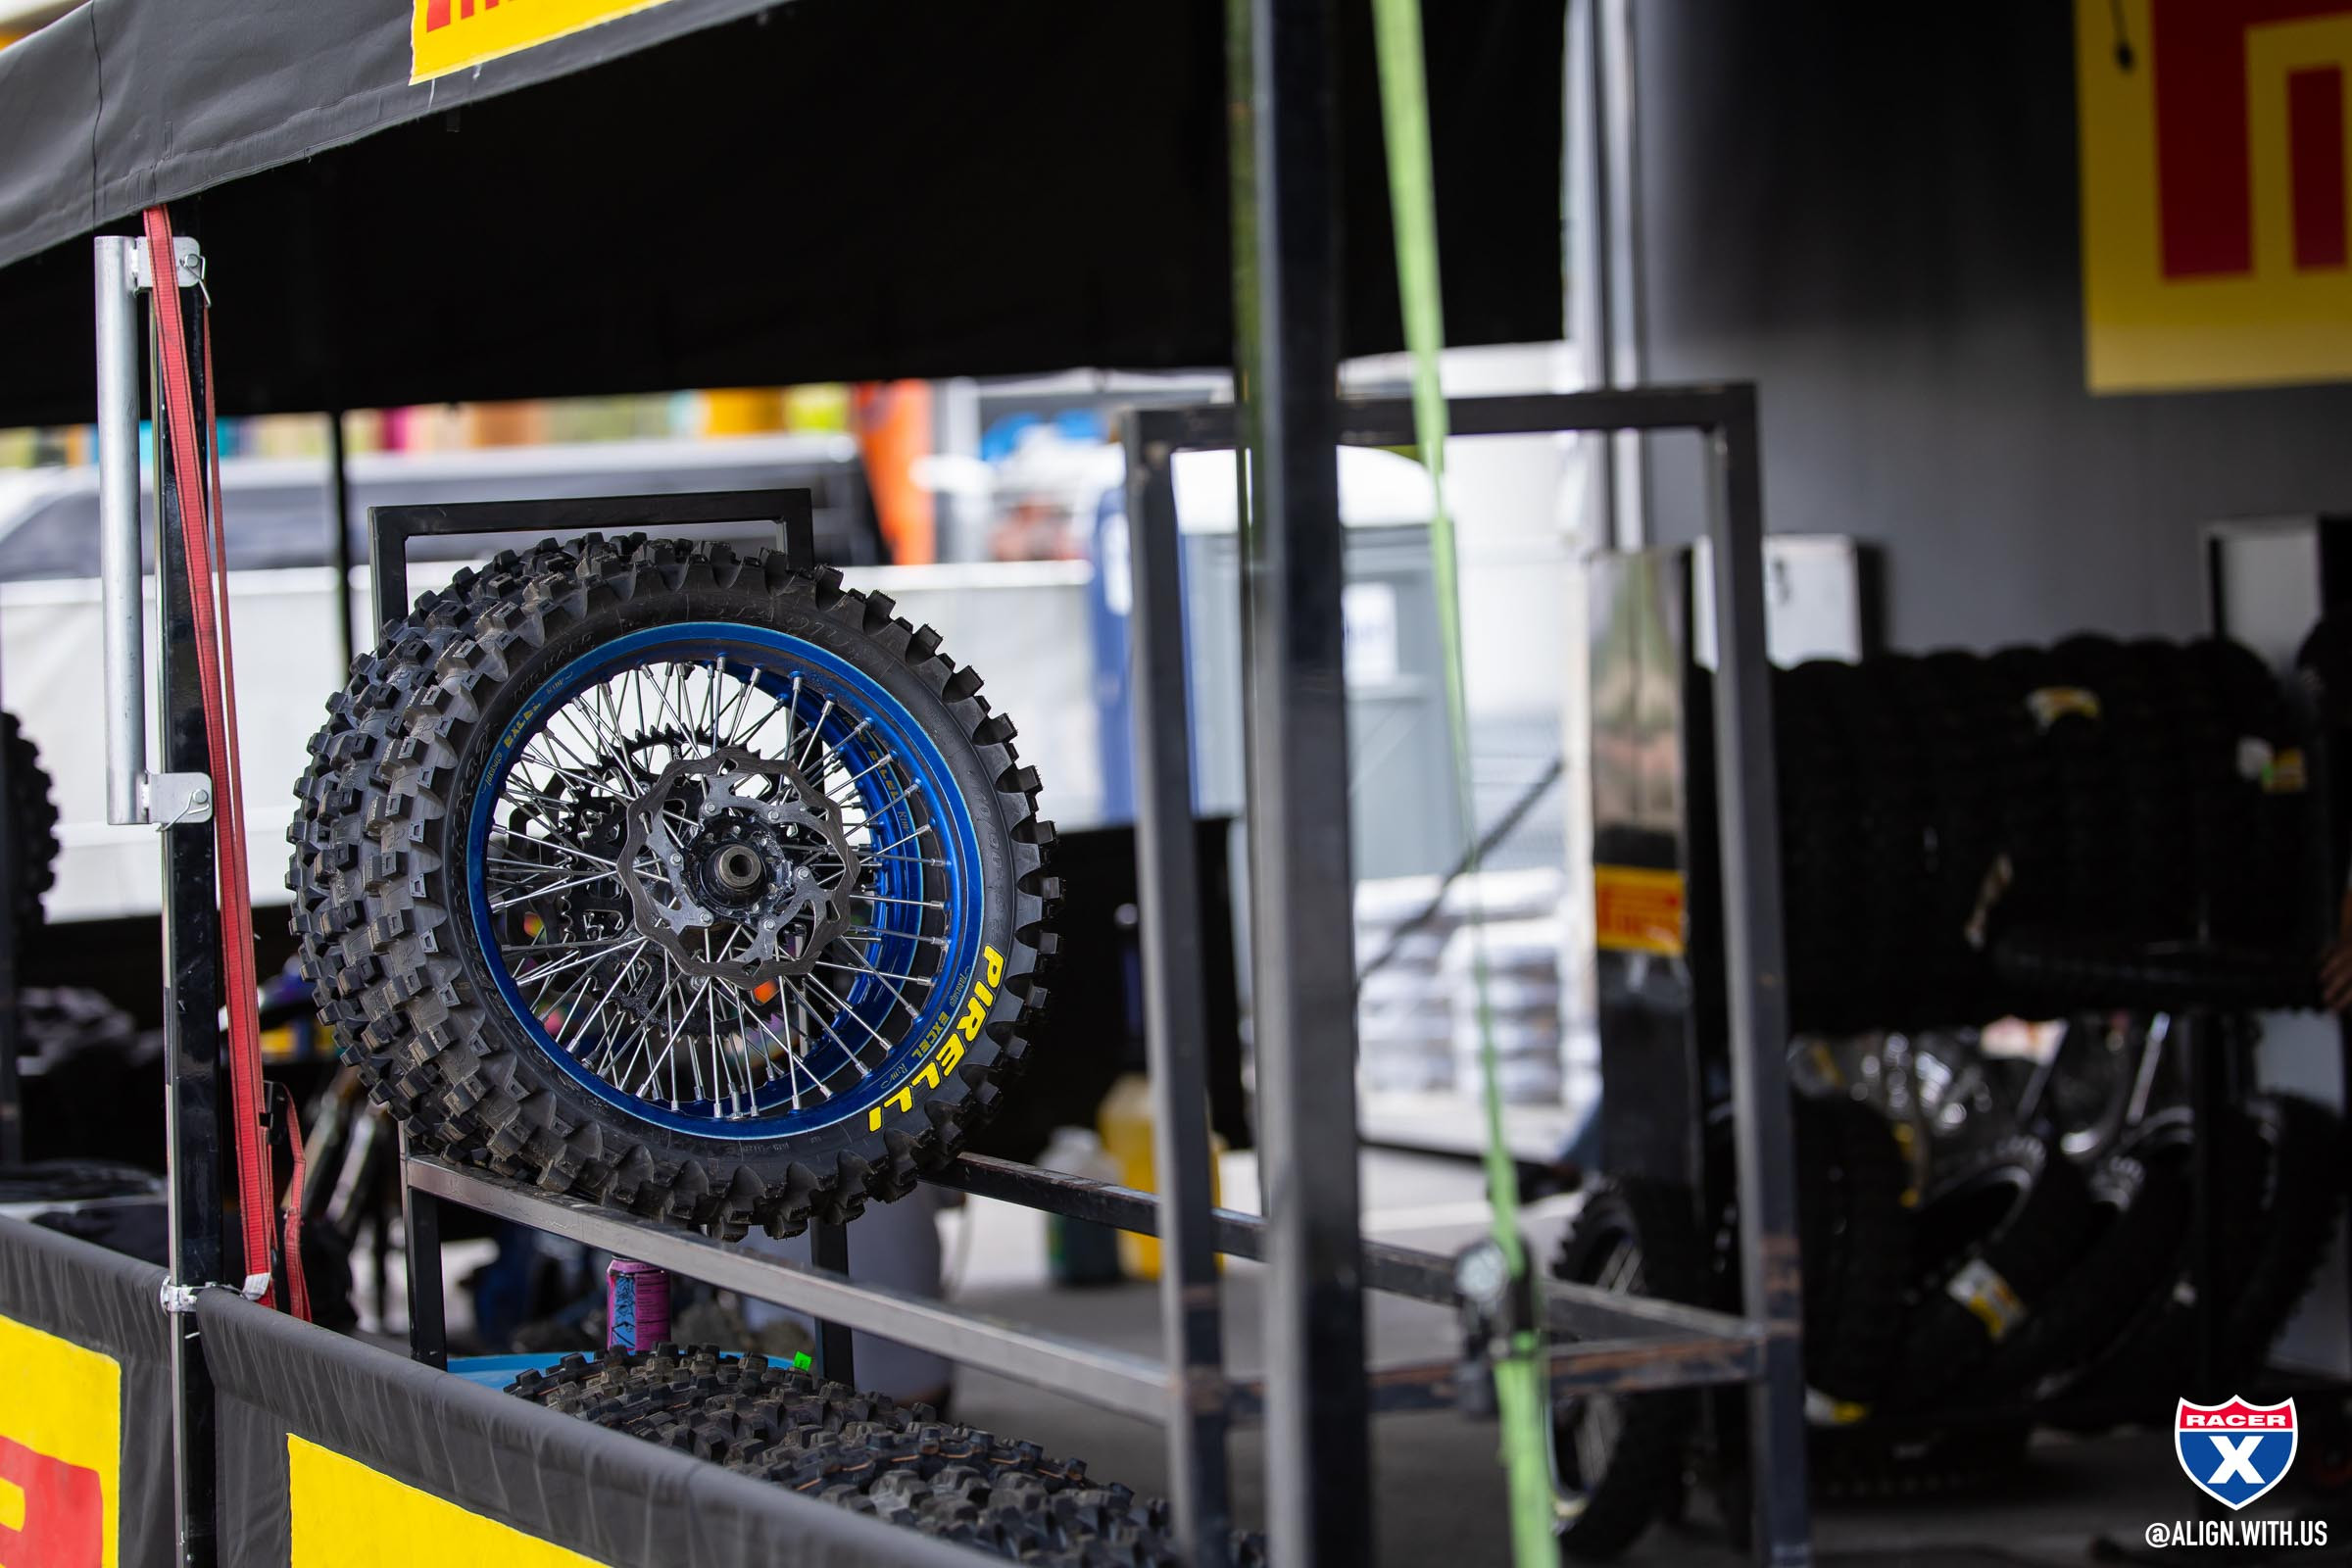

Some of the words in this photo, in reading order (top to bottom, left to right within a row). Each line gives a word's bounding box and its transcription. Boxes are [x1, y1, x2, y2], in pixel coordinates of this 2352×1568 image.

[868, 945, 1004, 1132] PIRELLI
[911, 1011, 950, 1058] EXCEL
[885, 1063, 907, 1084] Rim
